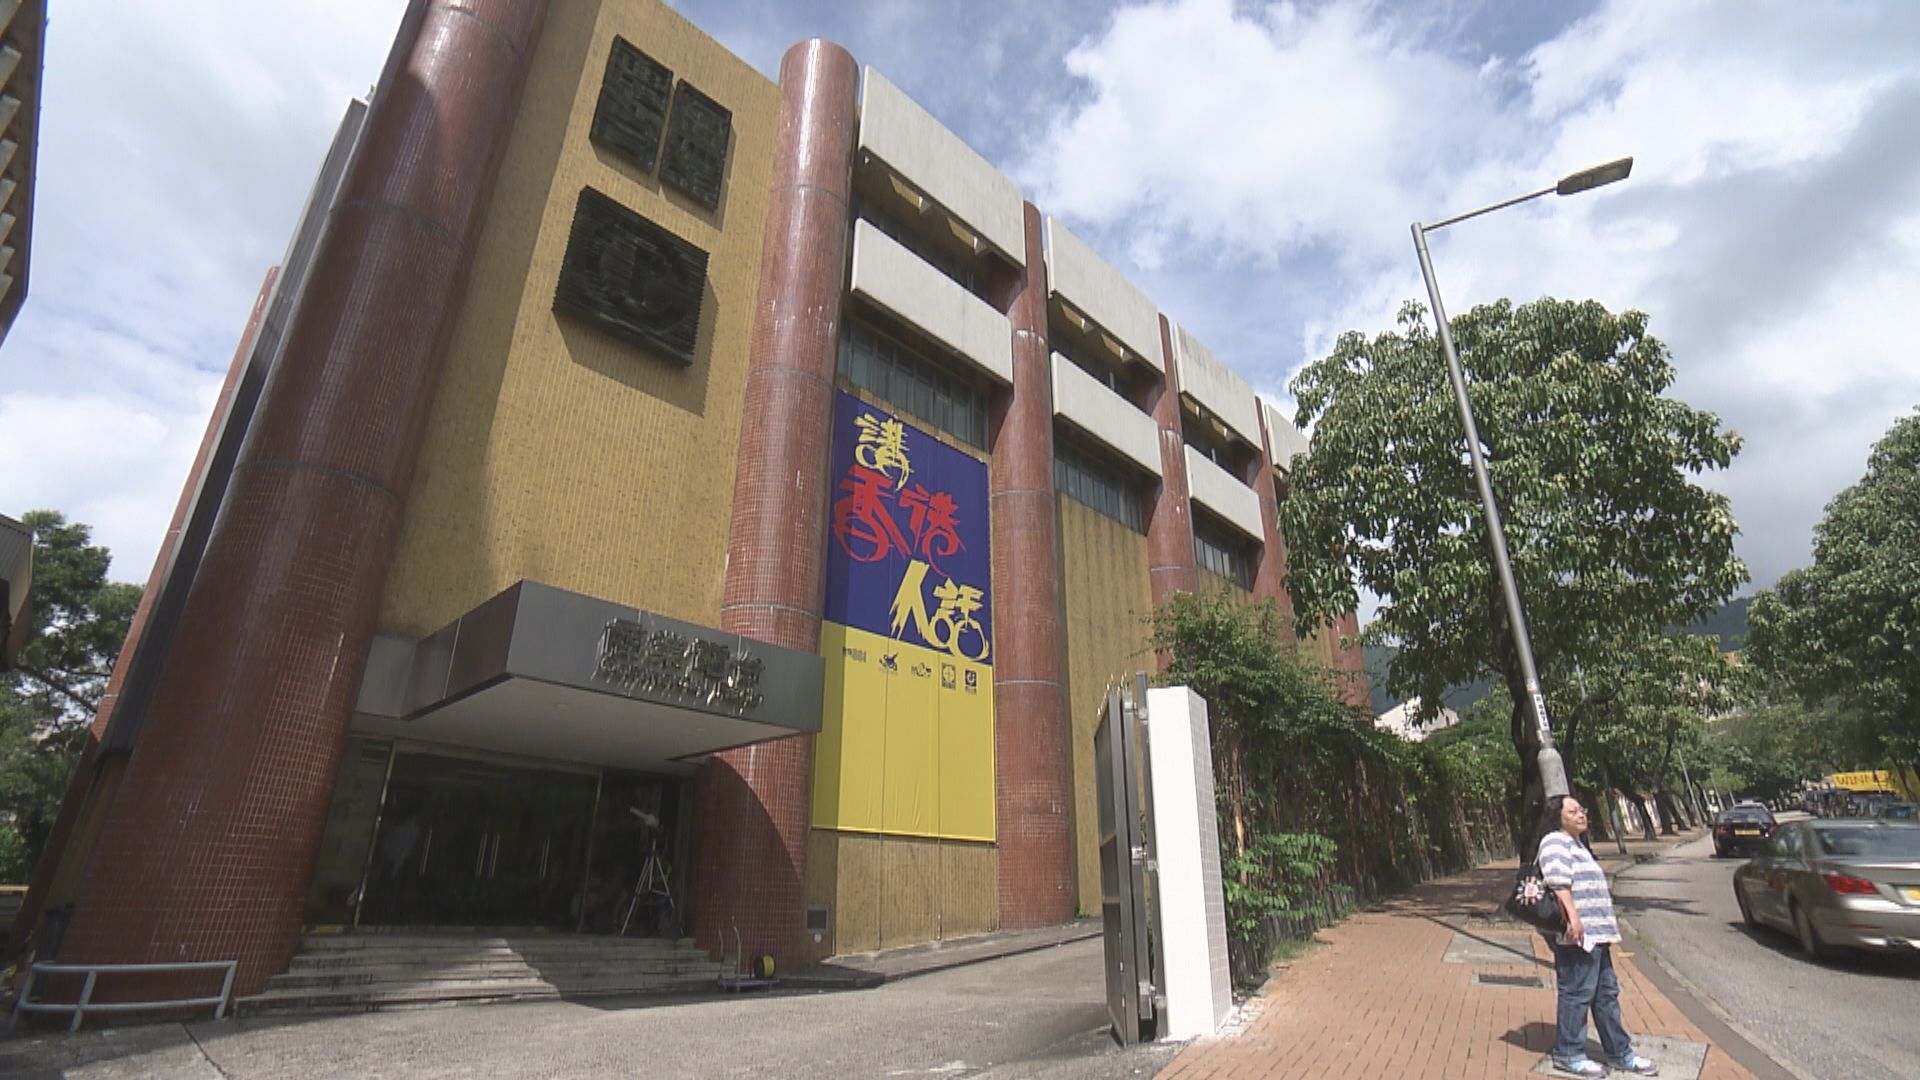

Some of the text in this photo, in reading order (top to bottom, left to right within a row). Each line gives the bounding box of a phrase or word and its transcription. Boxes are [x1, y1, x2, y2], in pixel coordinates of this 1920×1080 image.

[853, 413, 912, 491] 講
[832, 468, 966, 577] 香港
[891, 559, 991, 661] 人話
